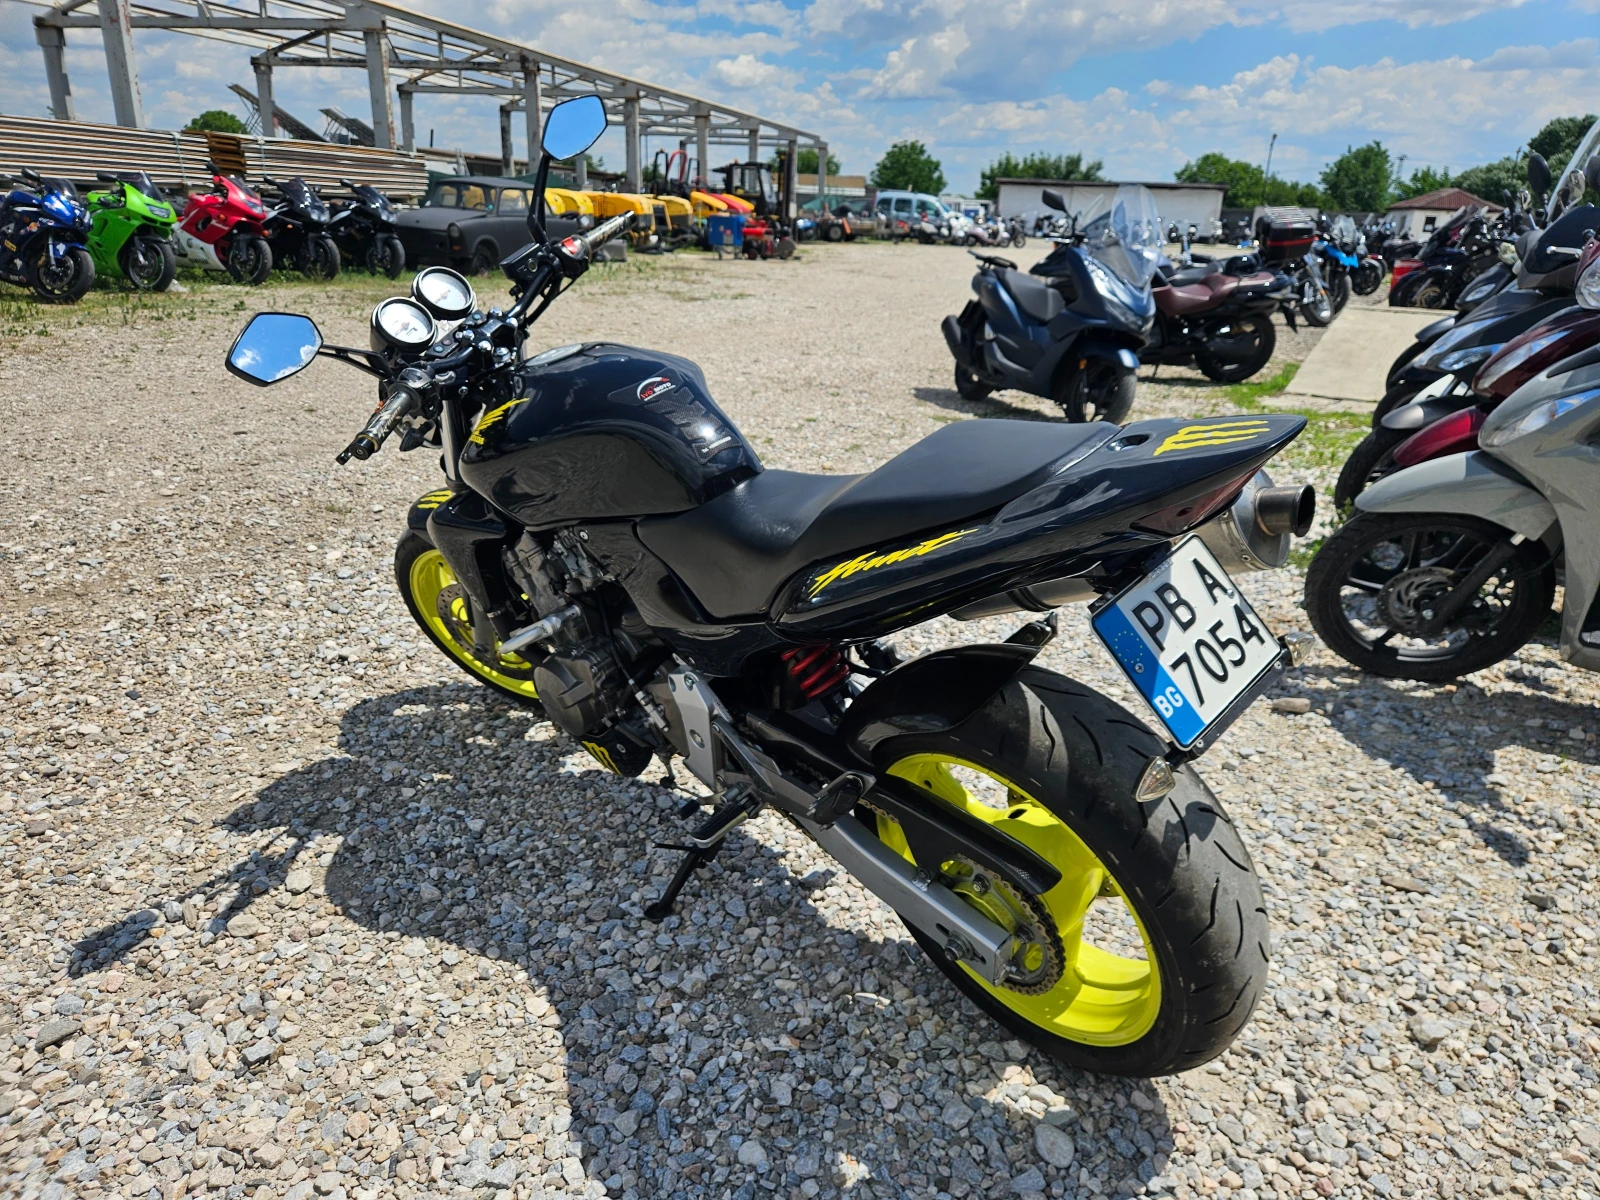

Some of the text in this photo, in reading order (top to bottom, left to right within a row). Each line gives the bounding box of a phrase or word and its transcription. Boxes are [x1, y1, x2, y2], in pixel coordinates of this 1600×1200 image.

[654, 382, 672, 393] MOTO
[1132, 558, 1230, 652] PB A
[1169, 604, 1266, 707] 7054
[1153, 686, 1184, 718] BG
